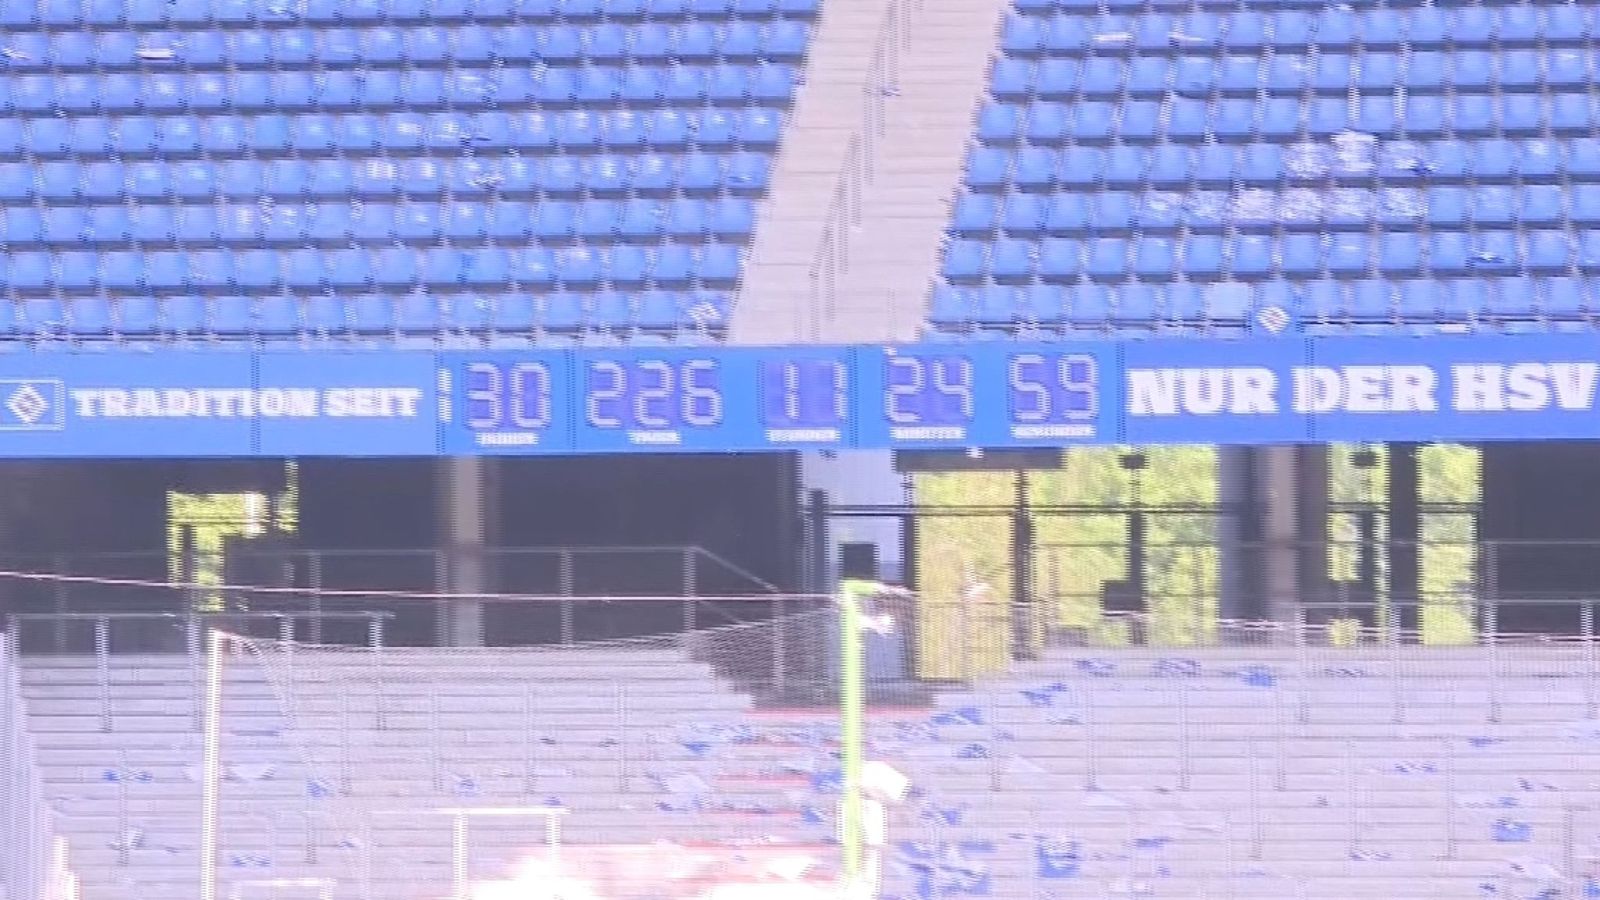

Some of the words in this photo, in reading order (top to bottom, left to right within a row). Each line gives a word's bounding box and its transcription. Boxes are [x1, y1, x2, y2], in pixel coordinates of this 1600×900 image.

[72, 387, 320, 418] TRADITION
[323, 387, 422, 418] SEIT
[586, 358, 723, 427] 226
[884, 356, 973, 423] 24
[1009, 353, 1098, 421] 59
[1126, 367, 1279, 416] NUR
[1290, 365, 1438, 414] DER
[1450, 361, 1599, 412] HSV
